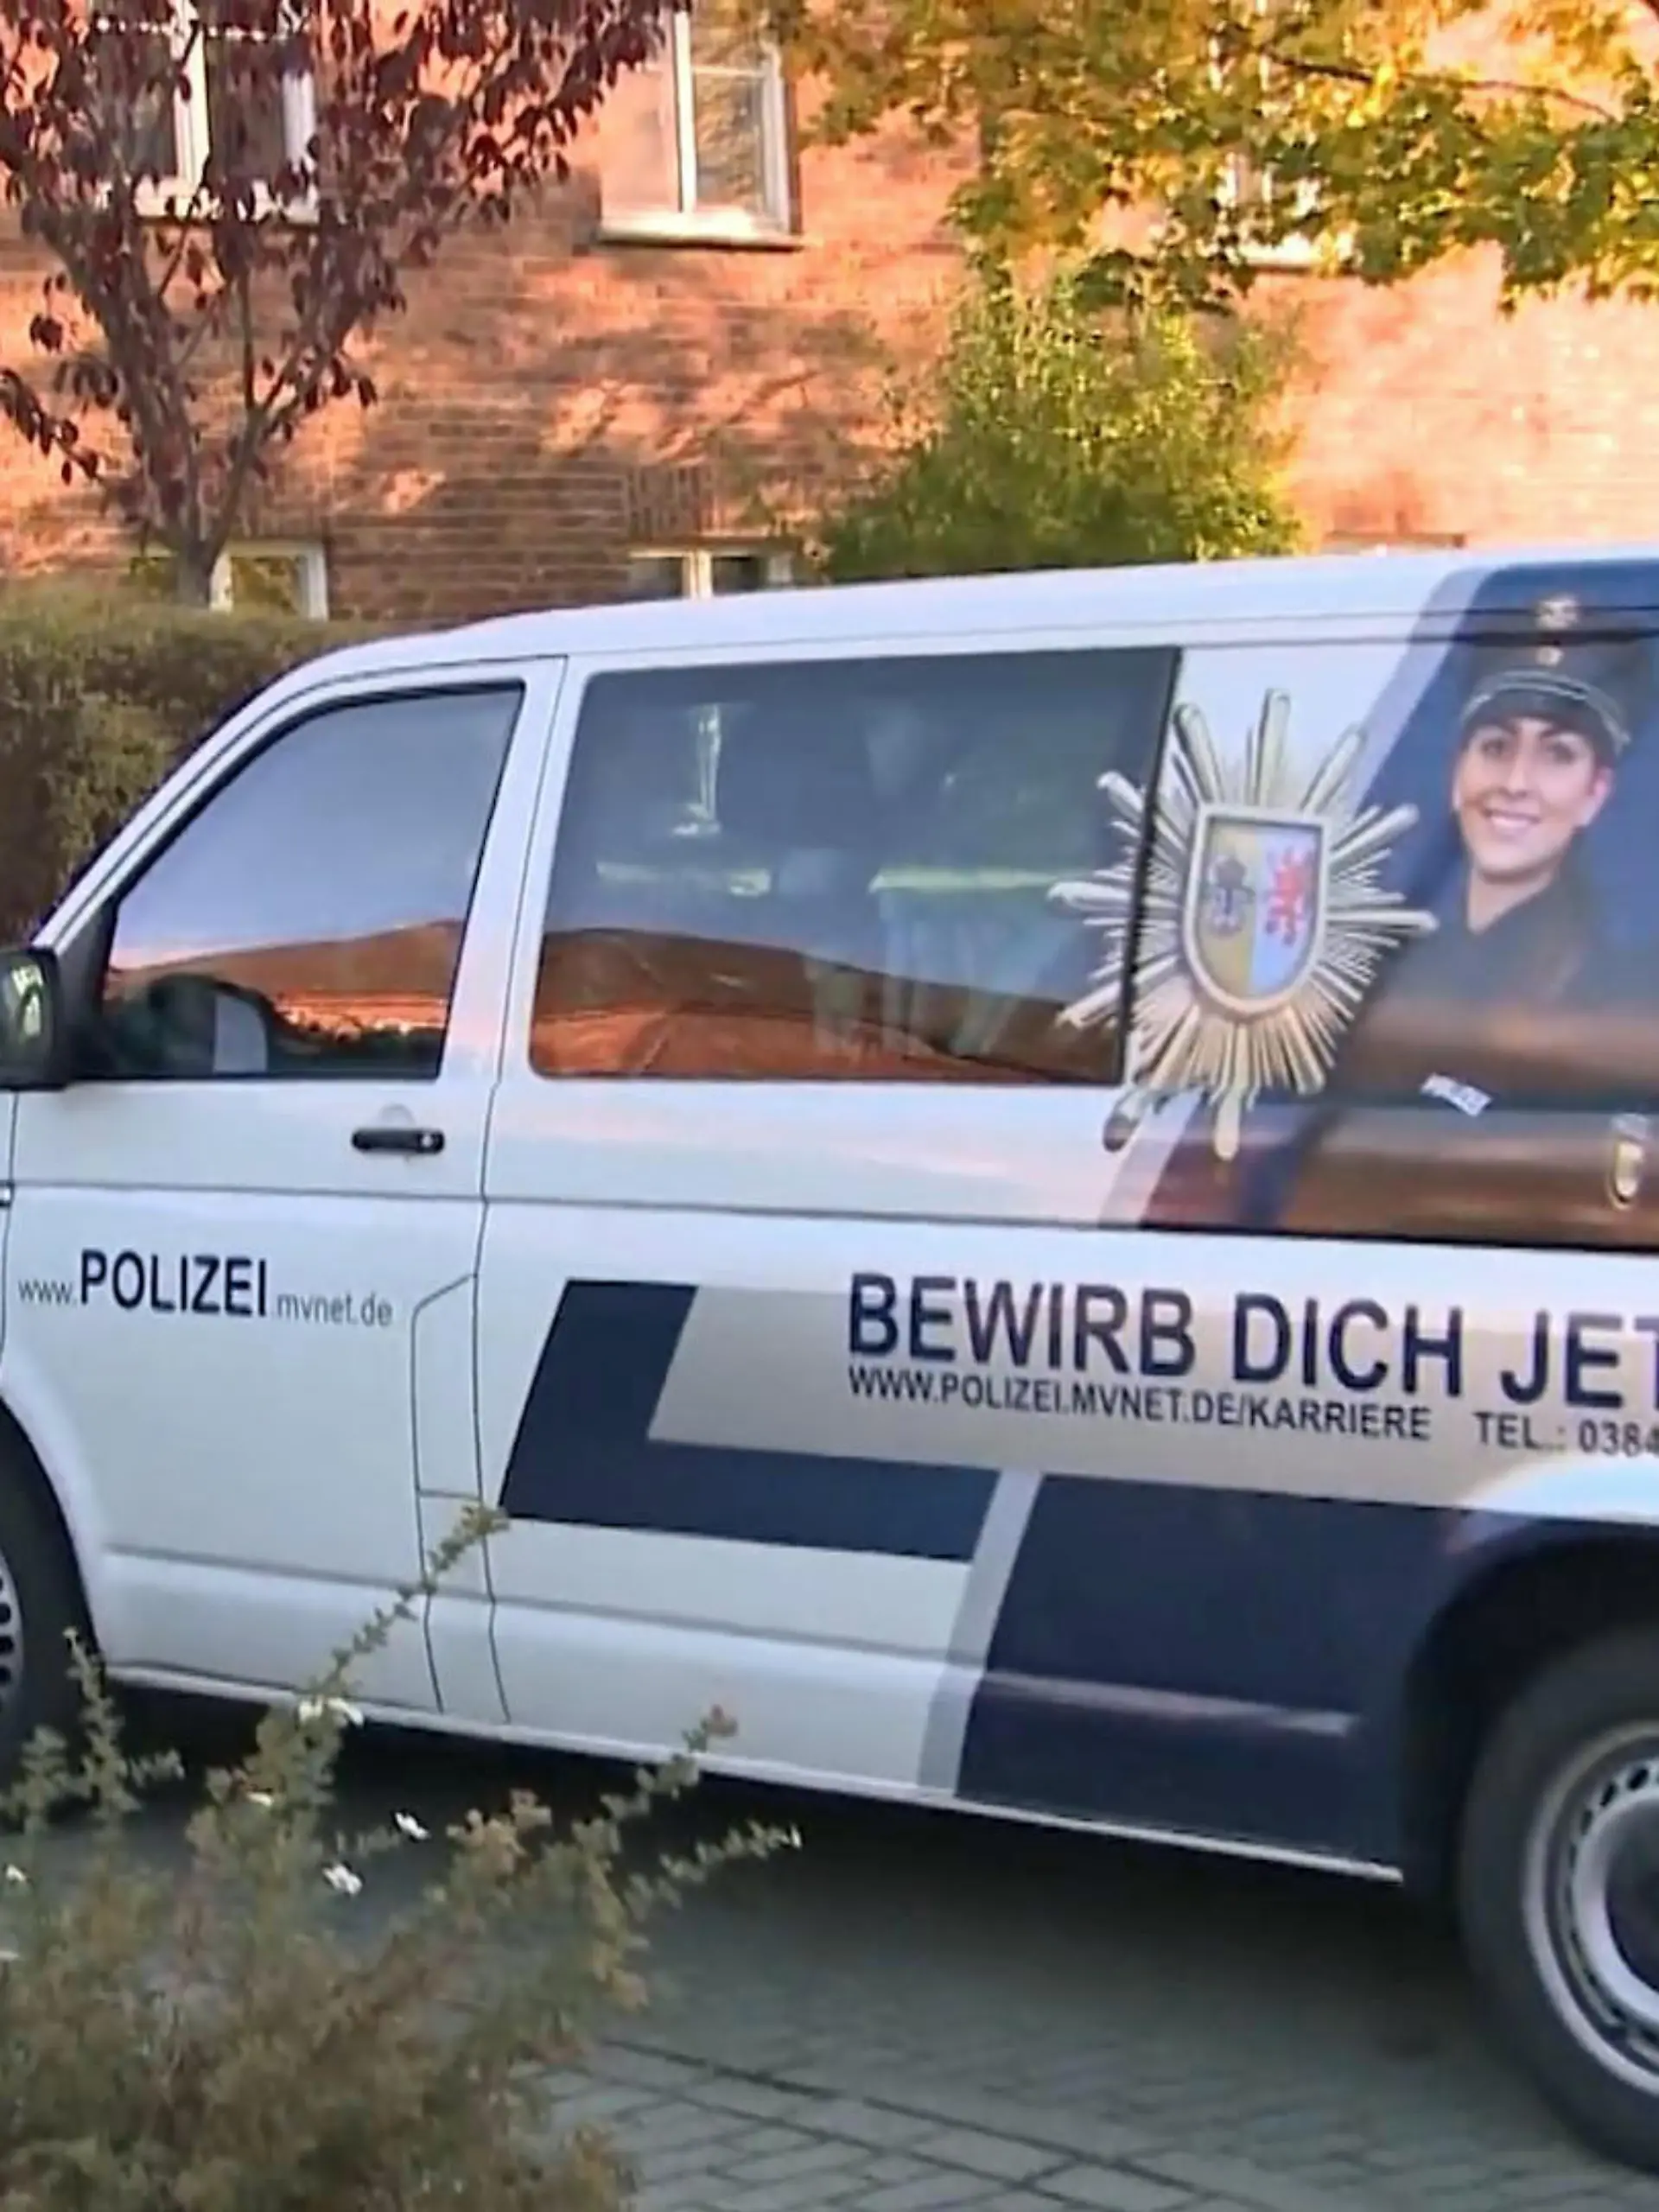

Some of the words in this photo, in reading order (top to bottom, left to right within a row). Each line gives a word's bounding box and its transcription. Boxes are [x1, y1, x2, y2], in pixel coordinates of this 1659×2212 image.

[849, 1273, 1196, 1376] BEWIRB
[1233, 1293, 1463, 1399] DICH
[849, 1365, 1431, 1441] WWW.POLIZEI.MVNET.DE/KARRIERE
